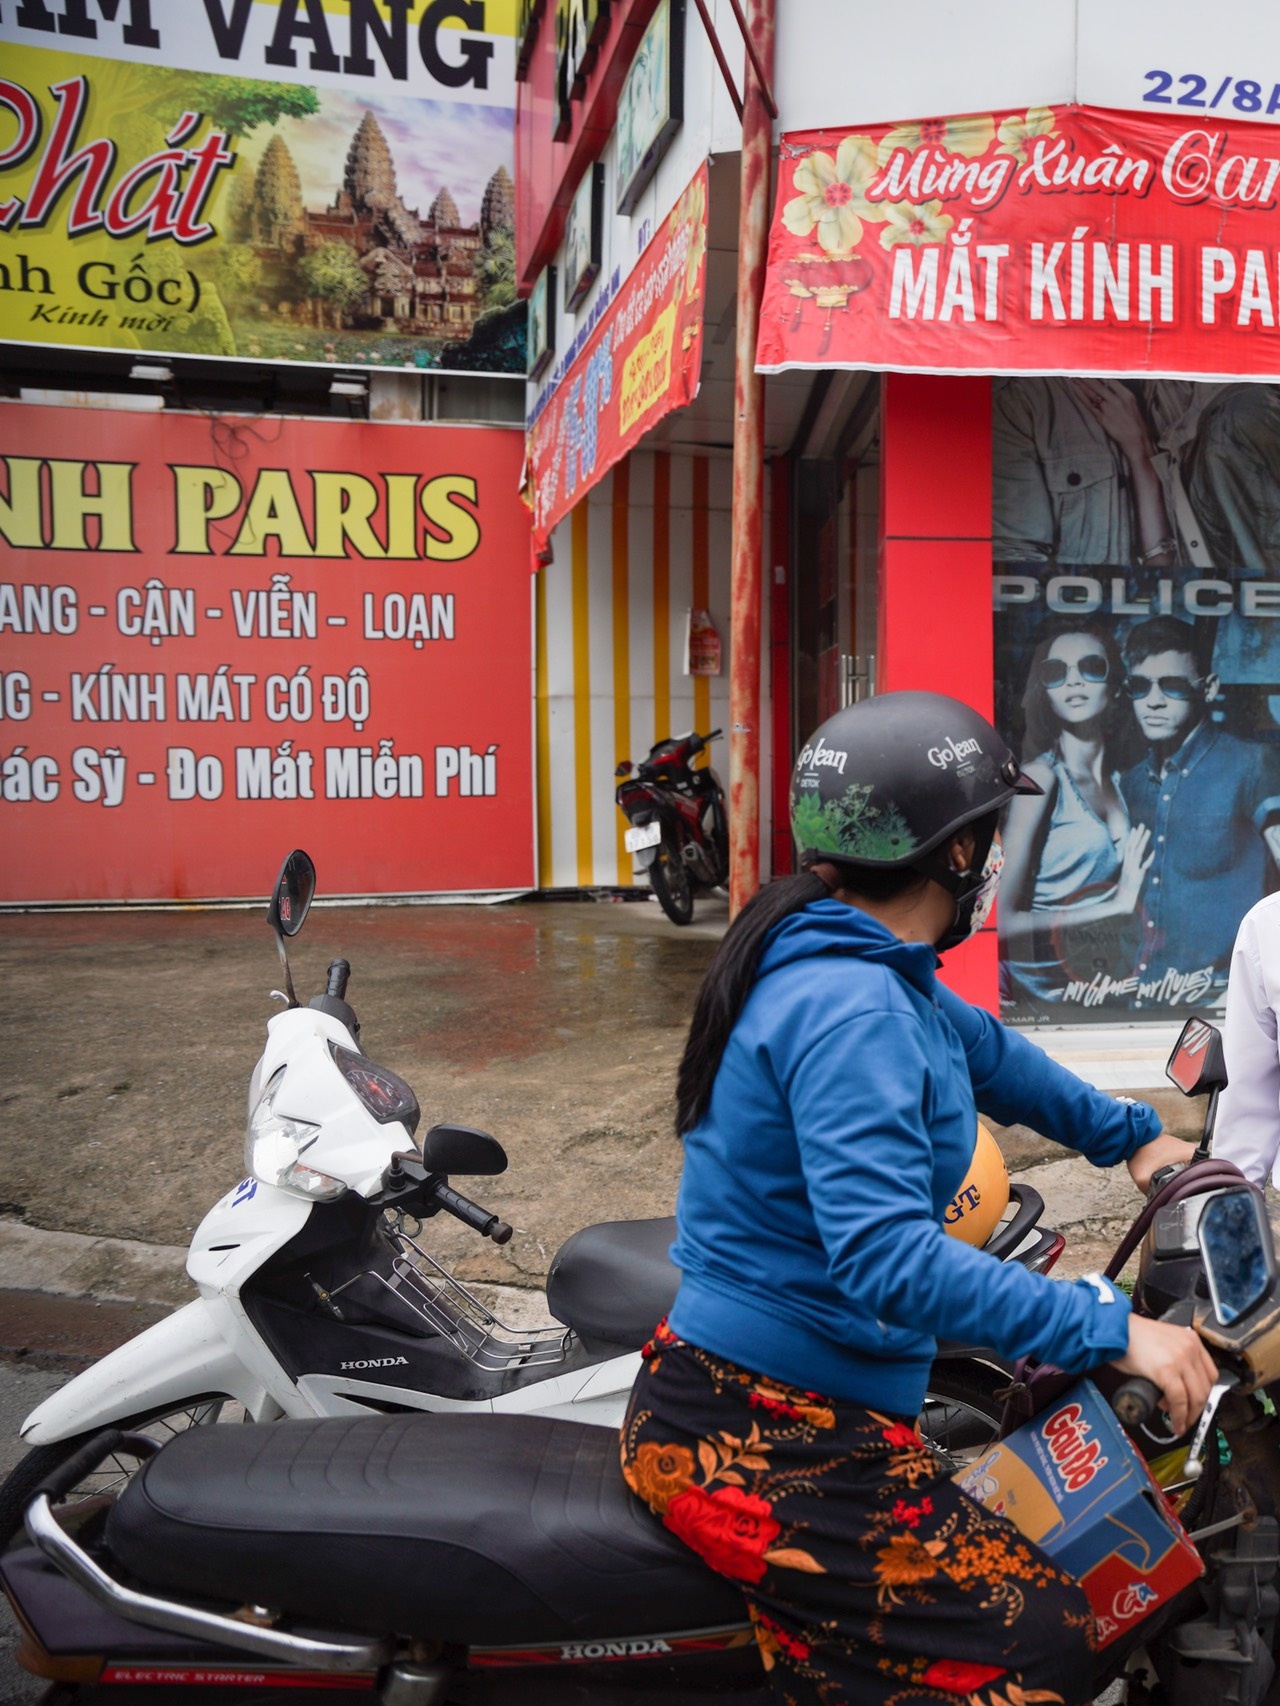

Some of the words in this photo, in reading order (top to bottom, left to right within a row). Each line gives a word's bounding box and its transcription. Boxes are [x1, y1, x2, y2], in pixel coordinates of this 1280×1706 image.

[197, 0, 494, 90] VANG
[871, 146, 1013, 206] Mừng
[1018, 138, 1150, 192] Xuân
[77, 253, 201, 313] Gốc)
[888, 218, 1010, 322] MẮT
[1030, 226, 1175, 322] KÍNH
[166, 463, 483, 563] PARIS
[116, 578, 196, 646] CẬN
[231, 574, 318, 640] VIỄN
[363, 593, 456, 649] LOẠN
[0, 671, 32, 722] G
[70, 663, 166, 722] KÍNH
[176, 663, 257, 722] MÁT
[265, 665, 313, 722] CÓ
[321, 666, 371, 732] ĐỘ
[0, 745, 60, 802] ác
[72, 745, 127, 807] Sỹ
[166, 746, 225, 801] Đo
[235, 740, 316, 800] Mắt
[325, 737, 424, 799] Miễn
[434, 743, 499, 799] Phí
[340, 1356, 409, 1370] HONDA
[114, 1671, 188, 1681] ELECTRIC
[194, 1673, 266, 1683] STARTER
[560, 1638, 673, 1660] HONDA
